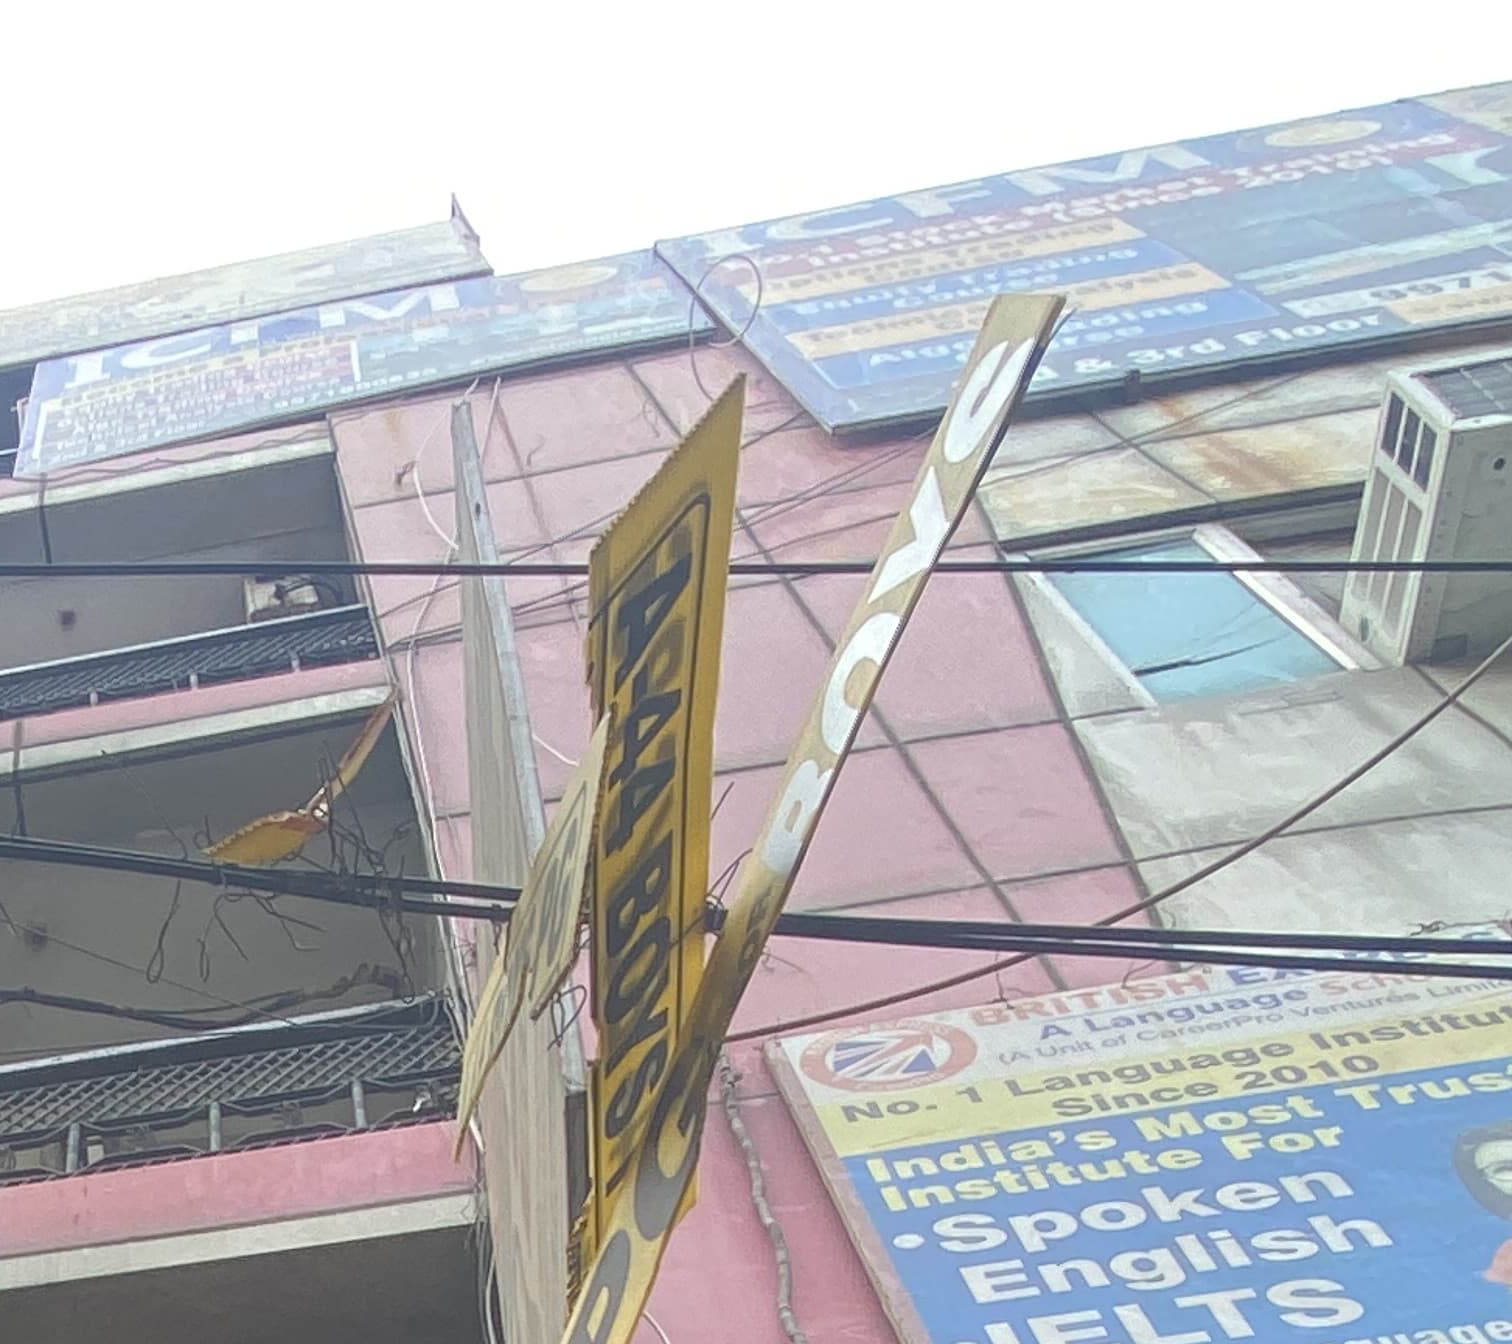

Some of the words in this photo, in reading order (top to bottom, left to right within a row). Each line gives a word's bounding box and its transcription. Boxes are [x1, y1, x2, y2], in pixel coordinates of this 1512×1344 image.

[686, 141, 1212, 261] ICFM
[1123, 335, 1229, 367] 3rd
[1231, 307, 1390, 349] Floor
[1040, 1023, 1071, 1041] A
[1083, 986, 1309, 1033] Language
[955, 1085, 984, 1104] 1
[1006, 1042, 1295, 1097] Language
[1051, 1080, 1219, 1118] Since
[1234, 1054, 1380, 1091] 2010
[864, 1128, 1120, 1184] India's
[1133, 1094, 1326, 1143] Most
[1333, 1062, 1512, 1111] Trus
[878, 1148, 1204, 1212] Institute
[1220, 1124, 1345, 1161] For
[931, 1167, 1356, 1254] Spoken
[958, 1214, 1394, 1304] English
